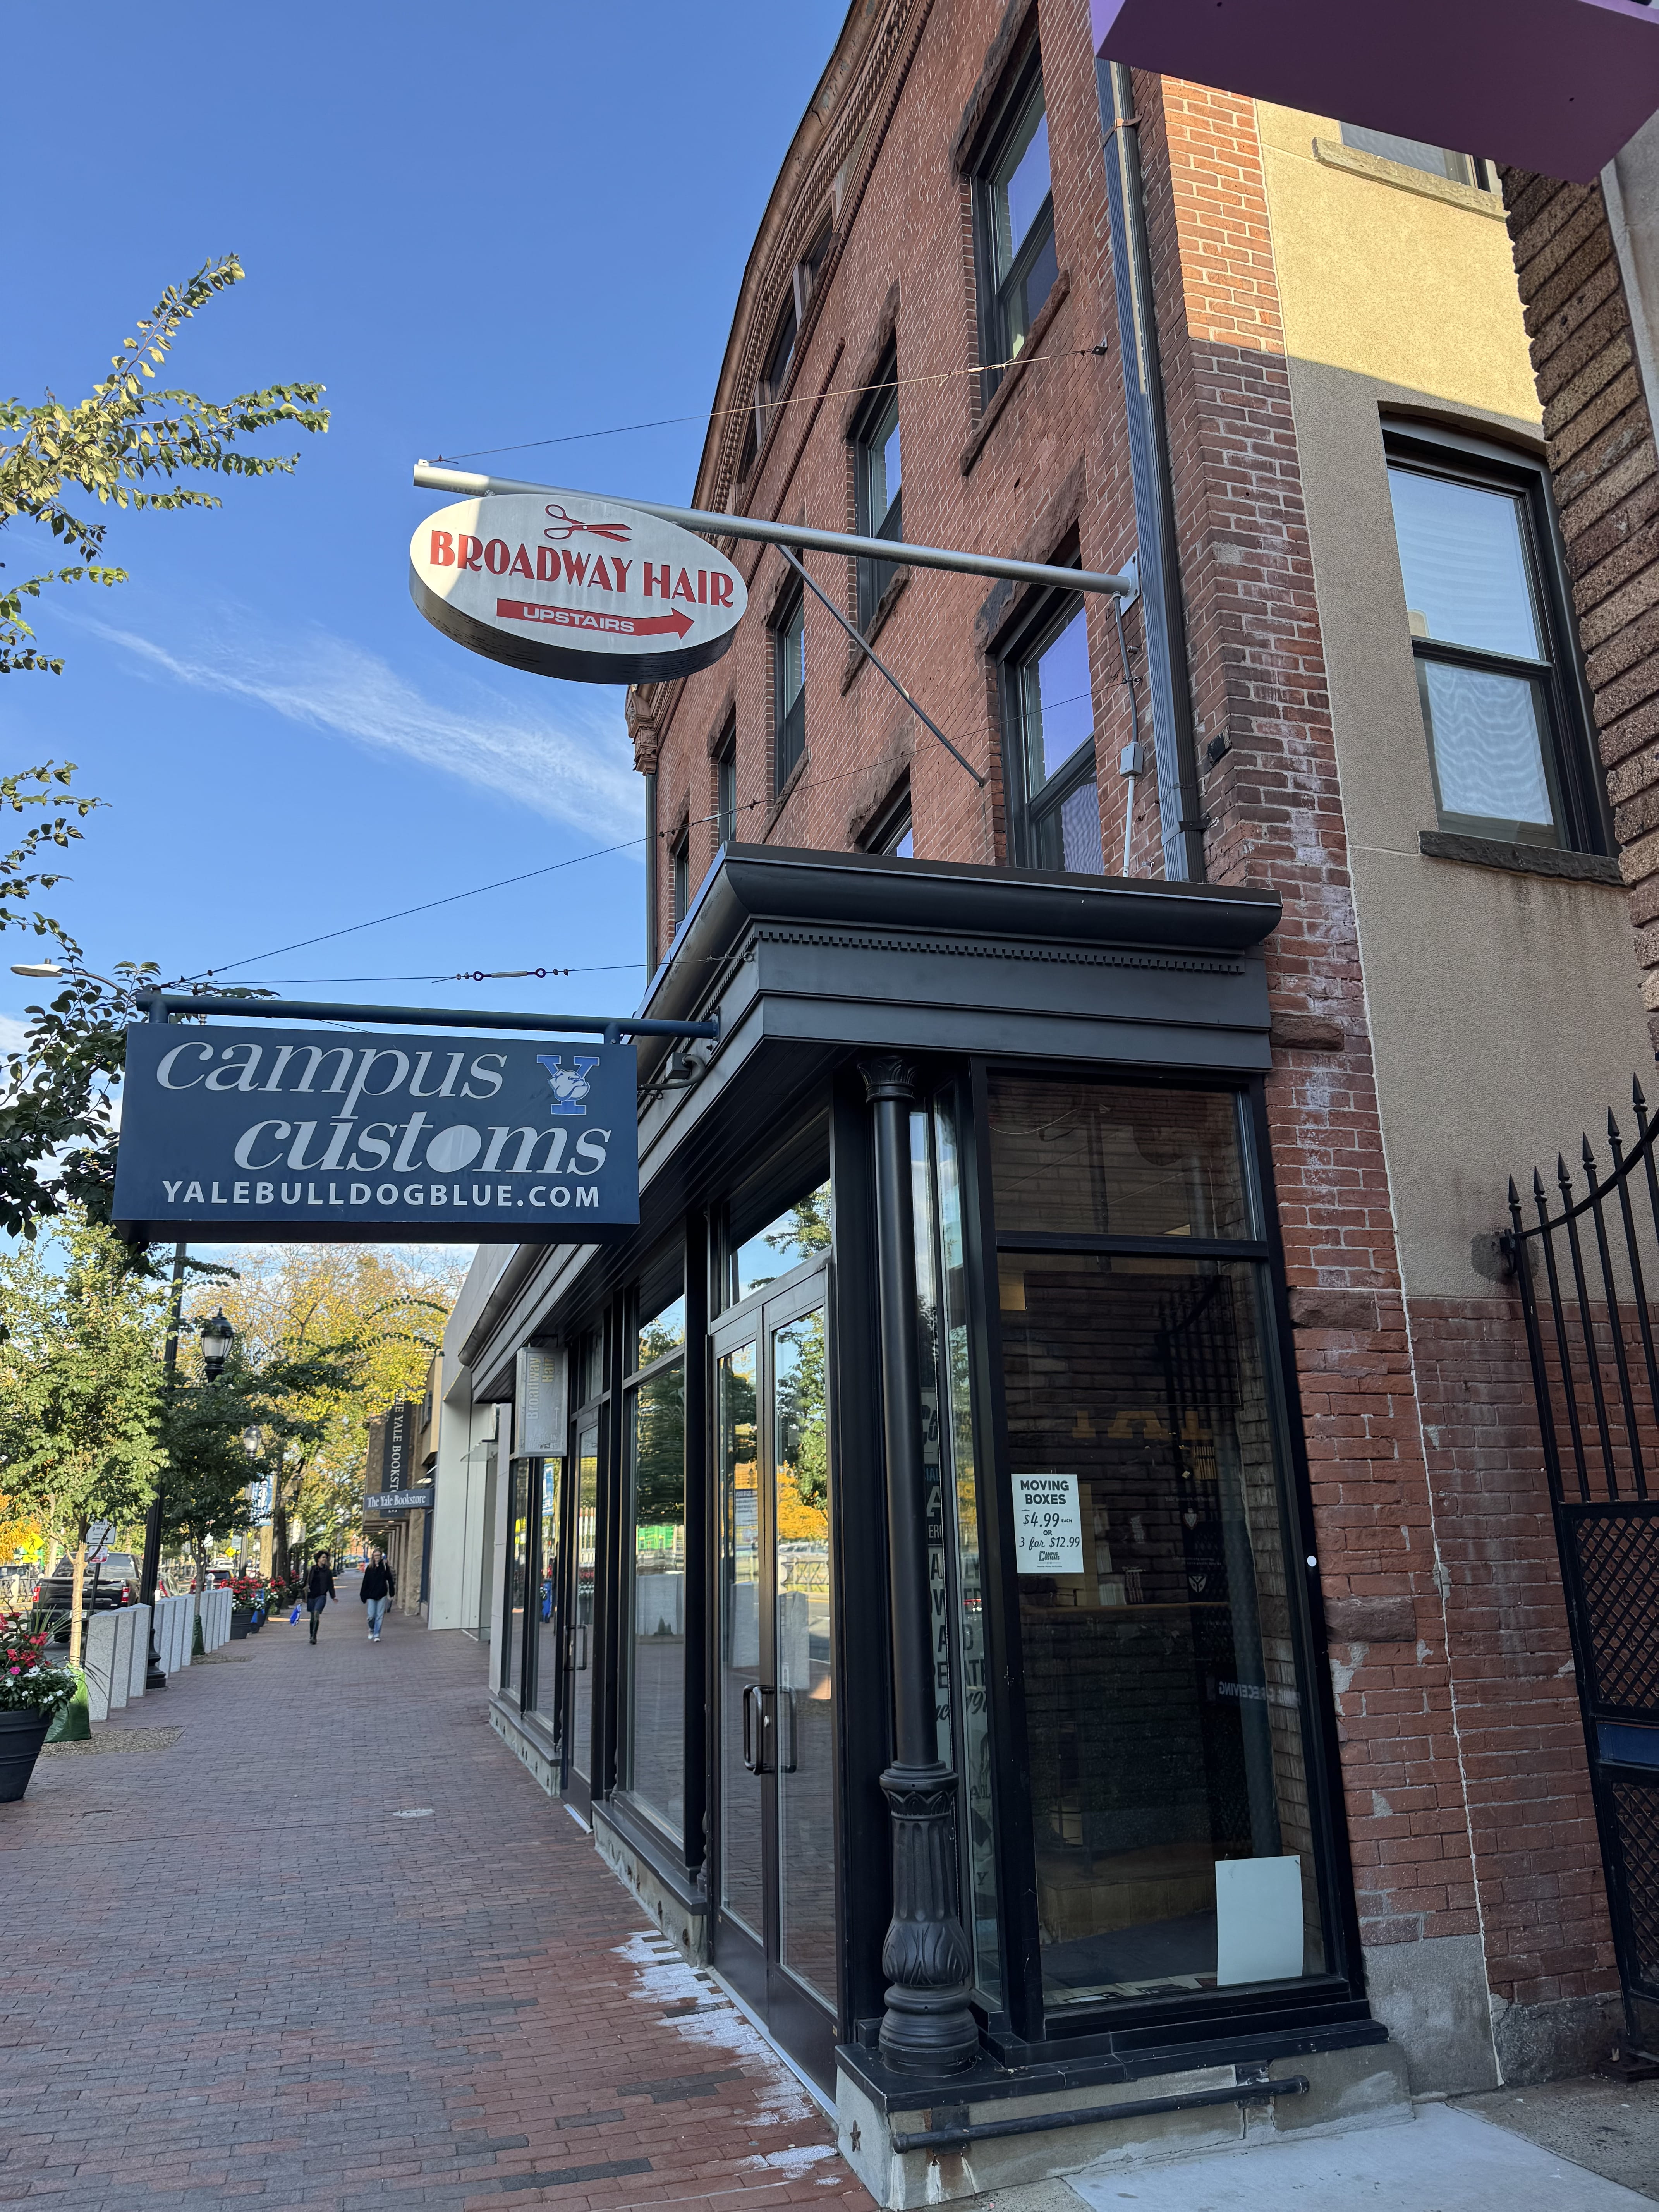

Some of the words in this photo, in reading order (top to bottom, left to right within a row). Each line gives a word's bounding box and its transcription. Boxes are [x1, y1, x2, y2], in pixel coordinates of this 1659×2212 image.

[430, 530, 633, 593] BROADWAY
[643, 561, 734, 608] HAIR
[522, 606, 634, 633] UPSTAIRS
[156, 1041, 508, 1119] campus
[234, 1111, 611, 1176] customs
[162, 1180, 599, 1207] YALEBULLDOGBLUE.COM
[541, 1357, 555, 1383] Hair
[526, 1357, 541, 1420] Broadway
[393, 1415, 404, 1442] YALE
[1020, 1480, 1069, 1491] MOVING
[1025, 1494, 1066, 1504] BOXES
[367, 1496, 379, 1508] The
[380, 1494, 393, 1507] Yale
[393, 1493, 426, 1506] Bookstore
[1023, 1512, 1060, 1527] $4.99
[1019, 1537, 1025, 1547] 3
[1029, 1537, 1045, 1551] for
[1049, 1537, 1080, 1549] $12.99
